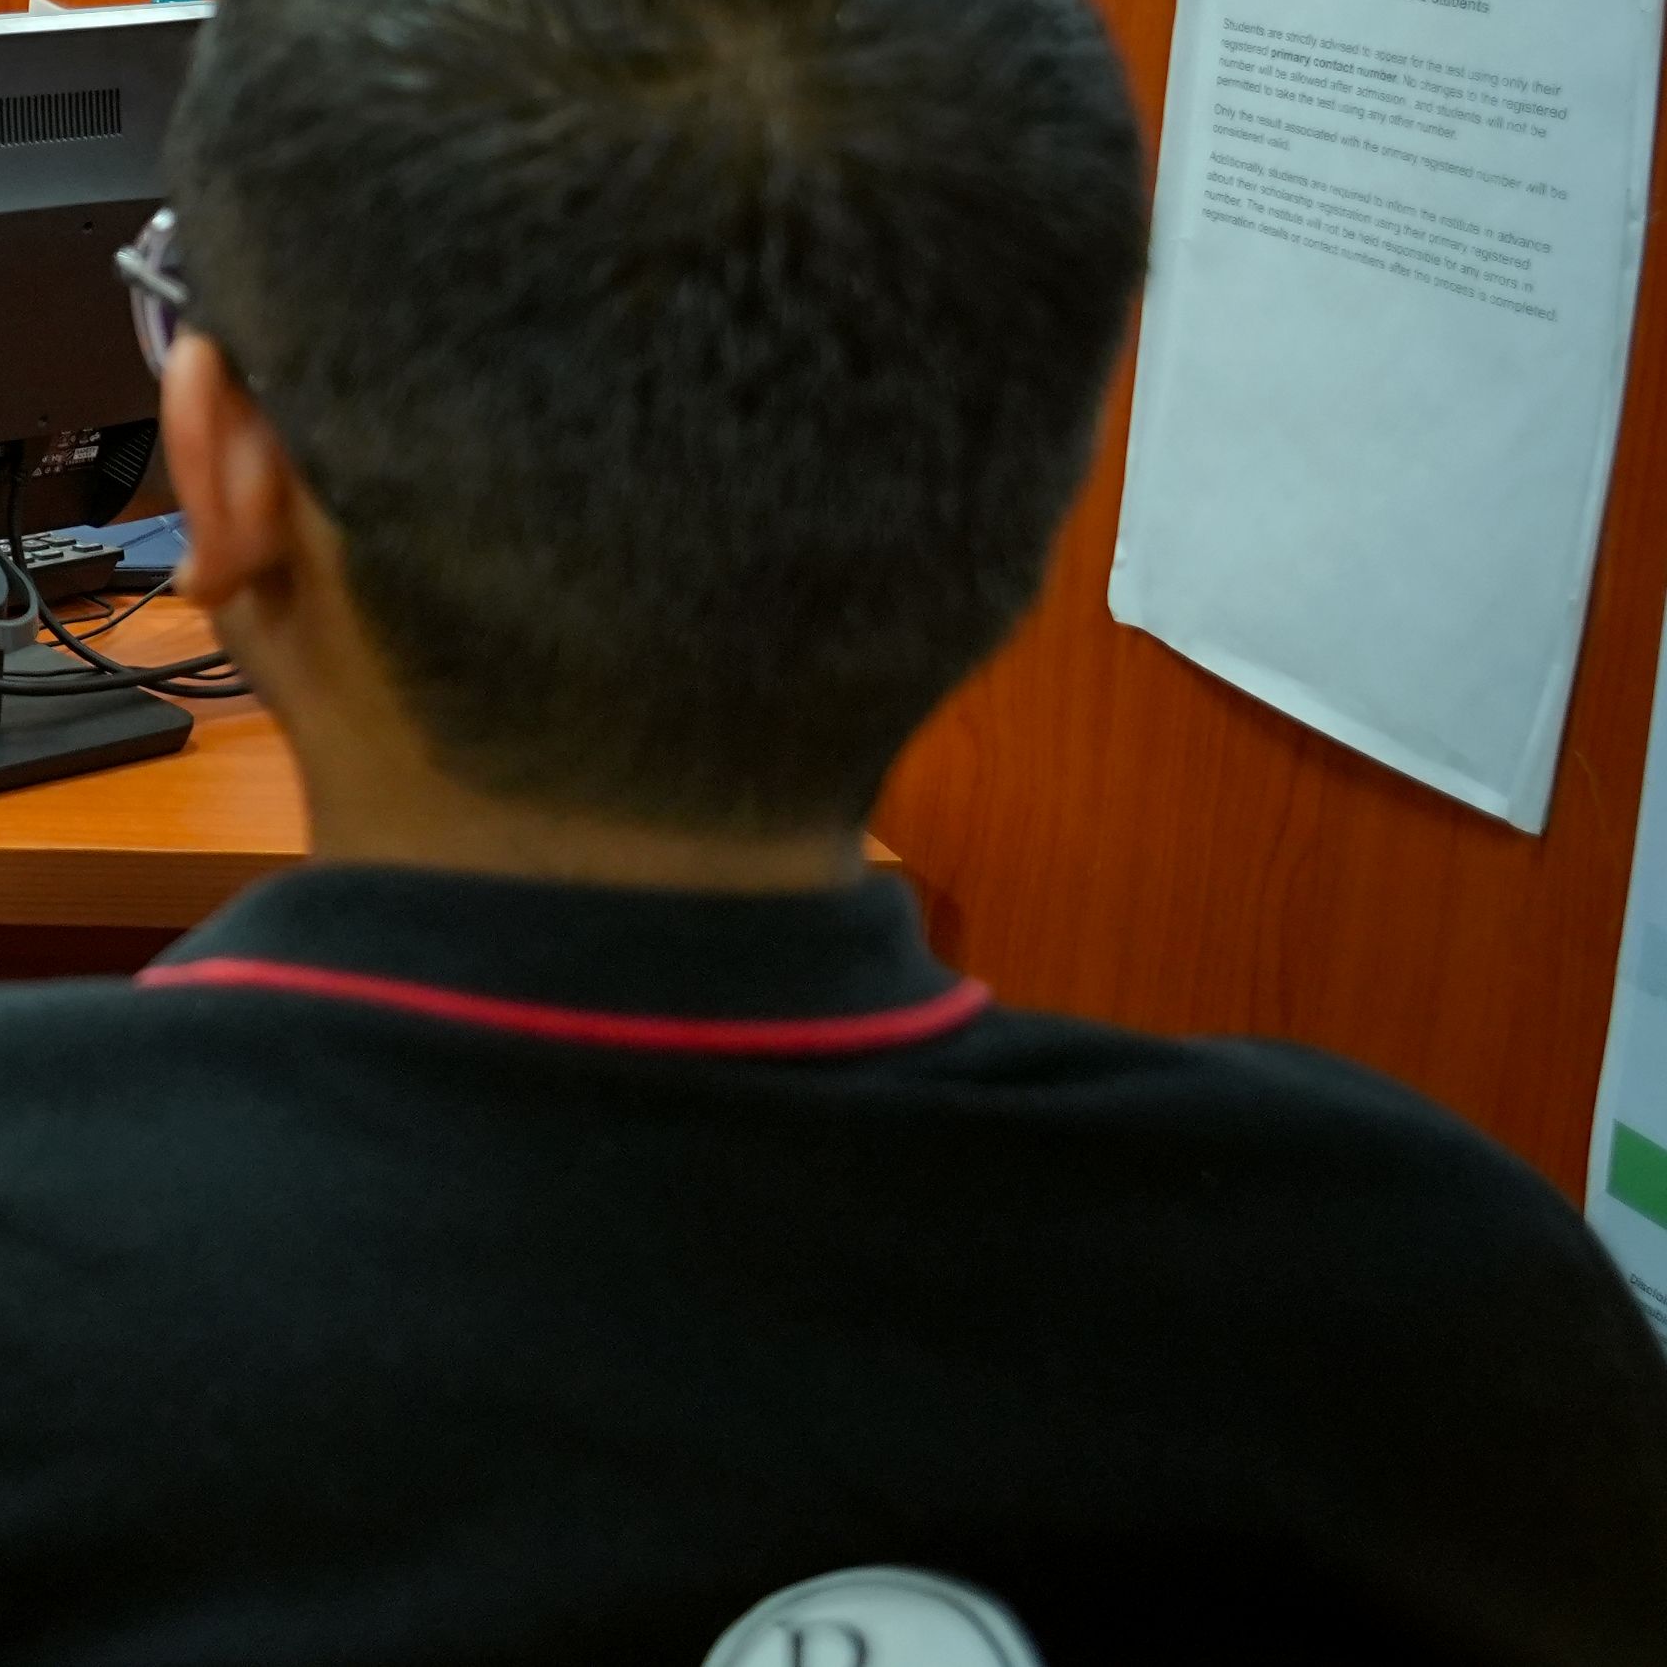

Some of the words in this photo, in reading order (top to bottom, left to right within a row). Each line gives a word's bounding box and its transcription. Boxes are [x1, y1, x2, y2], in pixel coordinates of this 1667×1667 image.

[1222, 18, 1264, 36] Students
[1270, 47, 1310, 68] primary
[1313, 56, 1354, 75] contact
